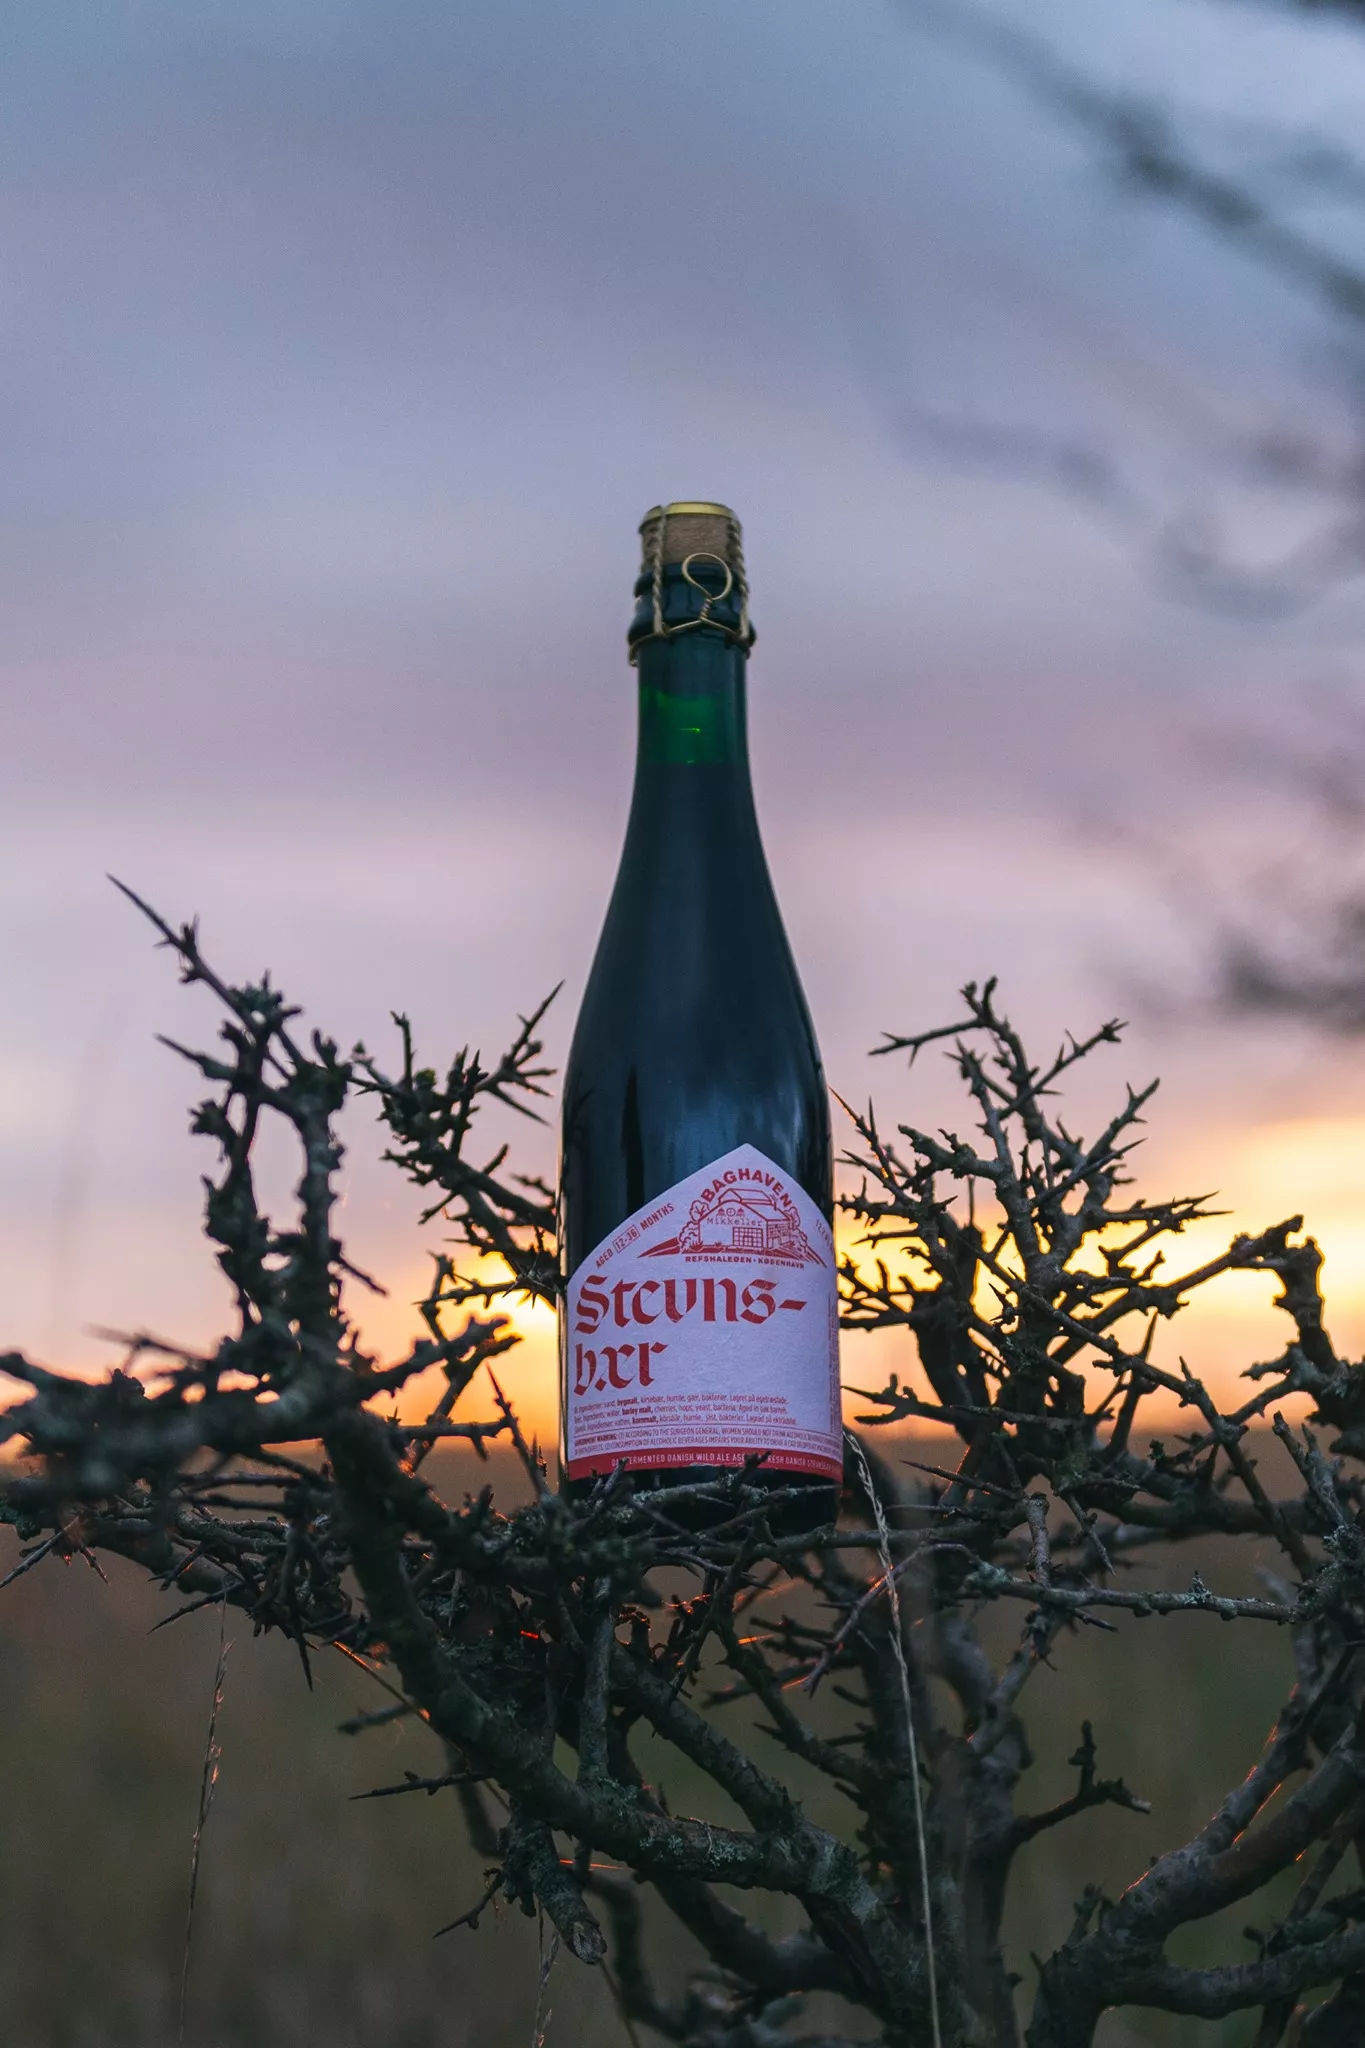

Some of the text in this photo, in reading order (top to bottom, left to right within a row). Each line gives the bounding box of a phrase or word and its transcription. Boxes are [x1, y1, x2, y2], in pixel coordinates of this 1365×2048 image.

[700, 1168, 792, 1207] BAGHAVEN
[706, 1217, 763, 1227] Mikkeller
[596, 1202, 675, 1269] AGED 12-36 MONTHS
[685, 1255, 752, 1264] REFSHALEØEN
[758, 1257, 805, 1270] KØBENHAVN
[740, 1404, 752, 1413] Aged
[625, 1430, 652, 1439] ACCORDING
[652, 1429, 659, 1437] TO
[660, 1428, 669, 1436] THE
[670, 1427, 695, 1436] SURGEON
[721, 1427, 741, 1436] WOMEN
[741, 1428, 761, 1436] SHOULD
[762, 1428, 770, 1437] NOT
[650, 1437, 677, 1445] ALCOHOLIC
[678, 1435, 708, 1444] BEVERAGES
[730, 1436, 744, 1444] YOUR
[626, 1454, 665, 1465] ERMENTED
[667, 1453, 694, 1463] DANISH
[696, 1452, 715, 1462] WILD
[717, 1452, 729, 1462] ALE
[732, 1452, 745, 1462] AGE
[767, 1454, 784, 1464] RESH
